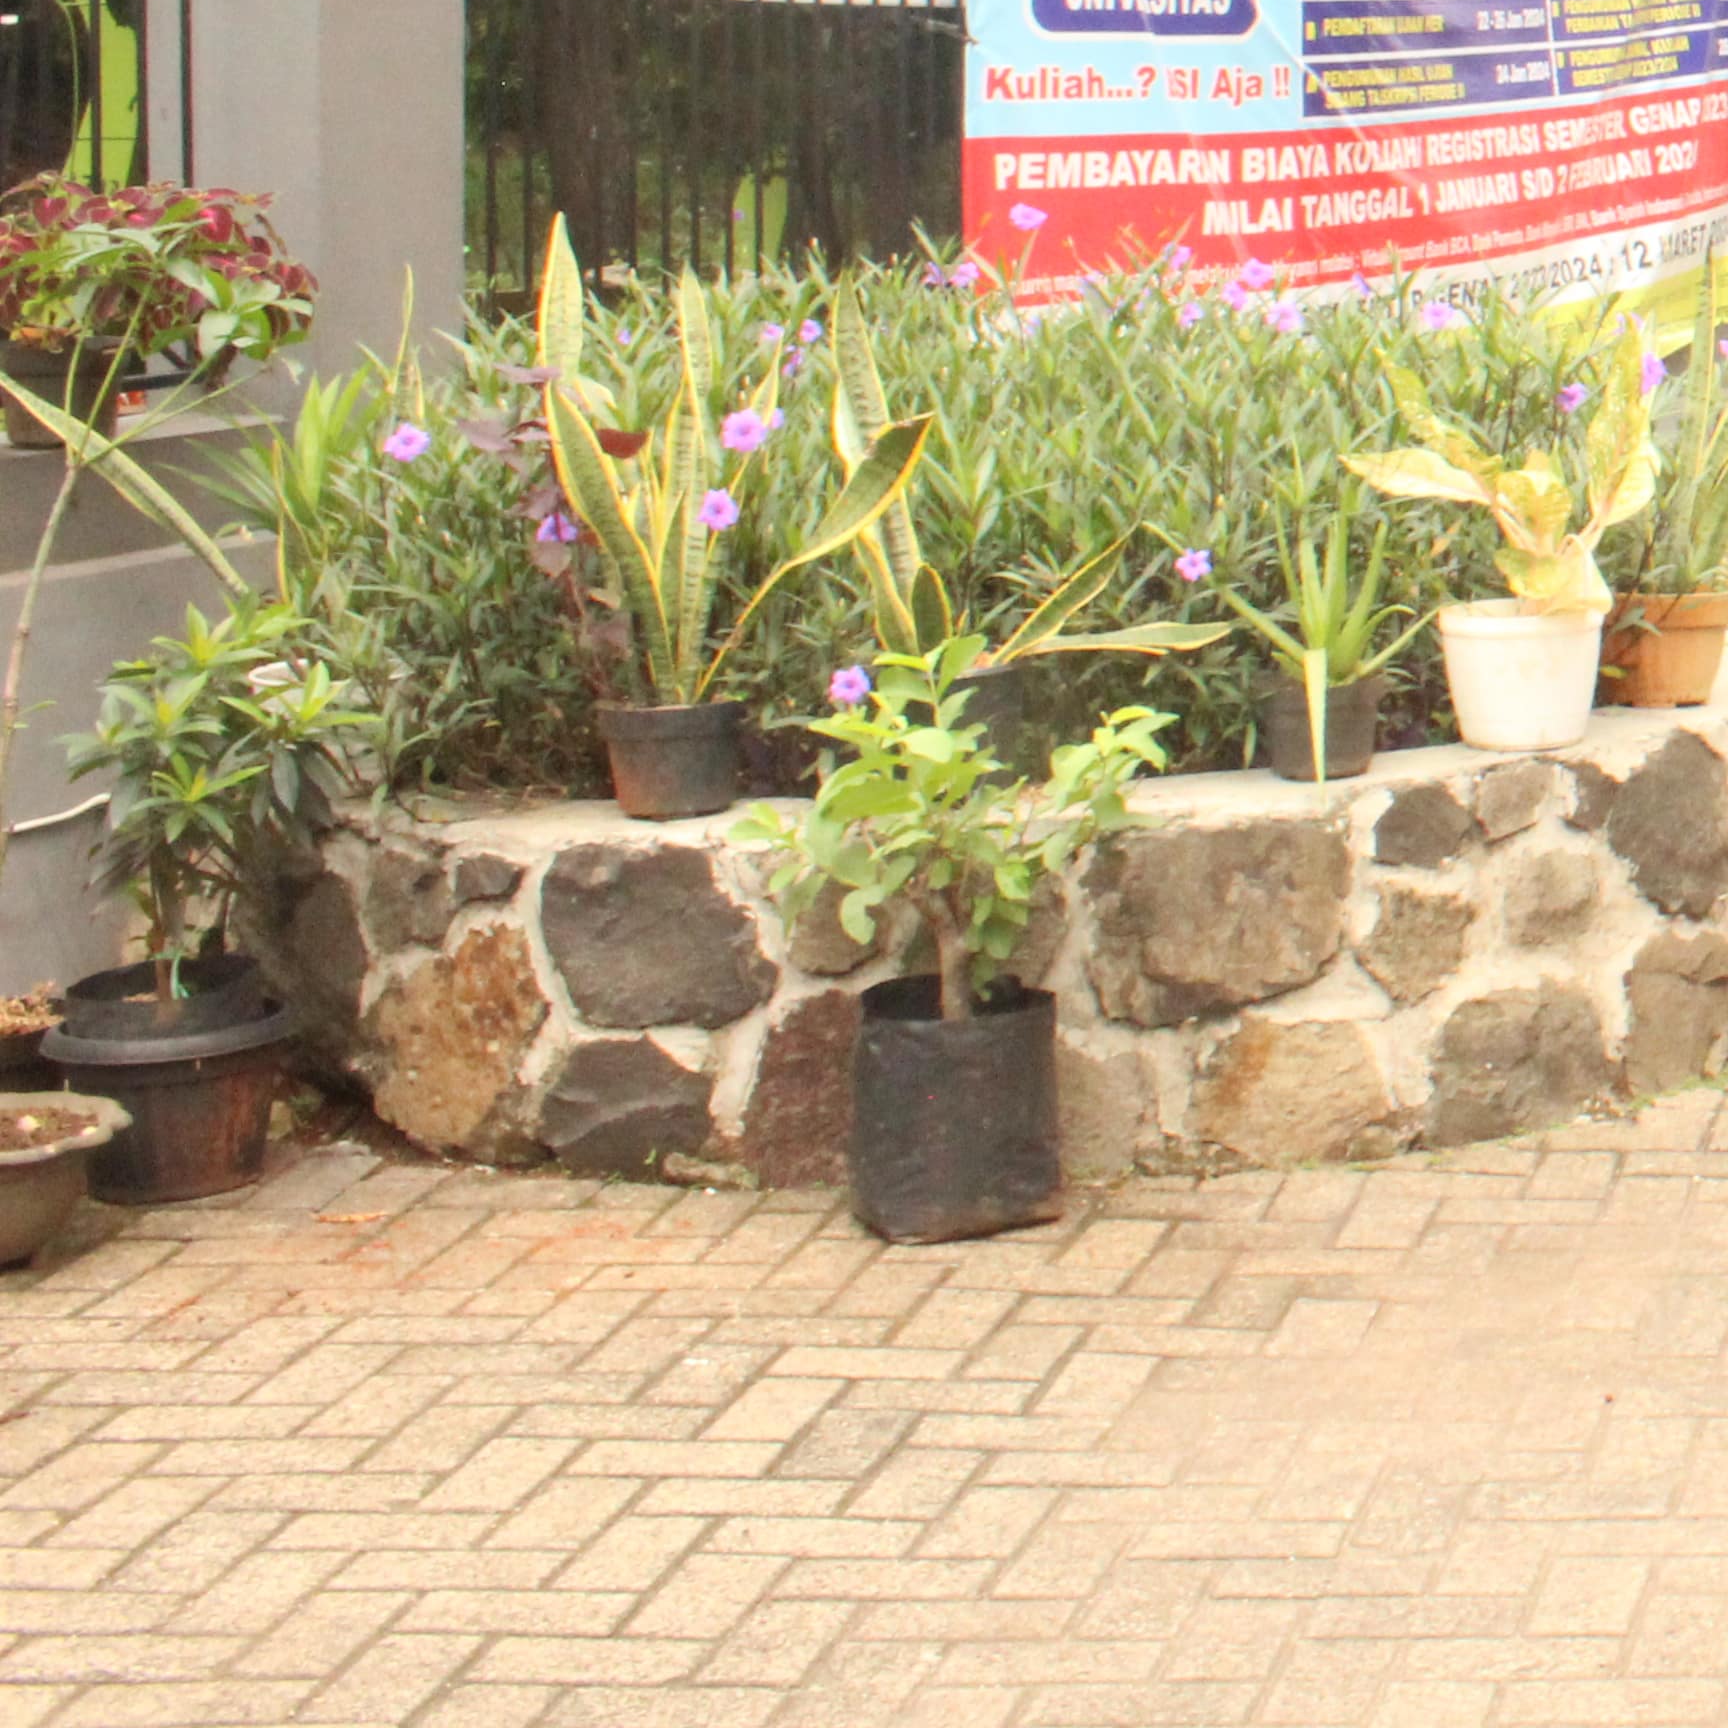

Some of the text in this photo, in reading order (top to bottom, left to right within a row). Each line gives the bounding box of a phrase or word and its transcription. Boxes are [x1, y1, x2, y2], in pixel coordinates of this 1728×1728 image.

[1210, 66, 1264, 107] Aja
[1242, 143, 1331, 184] BIAYA
[1426, 127, 1541, 167] REGISTRASI
[1629, 96, 1701, 135] GENAP
[1300, 184, 1413, 231] TANGGAL
[1434, 174, 1519, 215] JANUARI
[1521, 165, 1555, 200] S/D
[1622, 238, 1653, 275] 12
